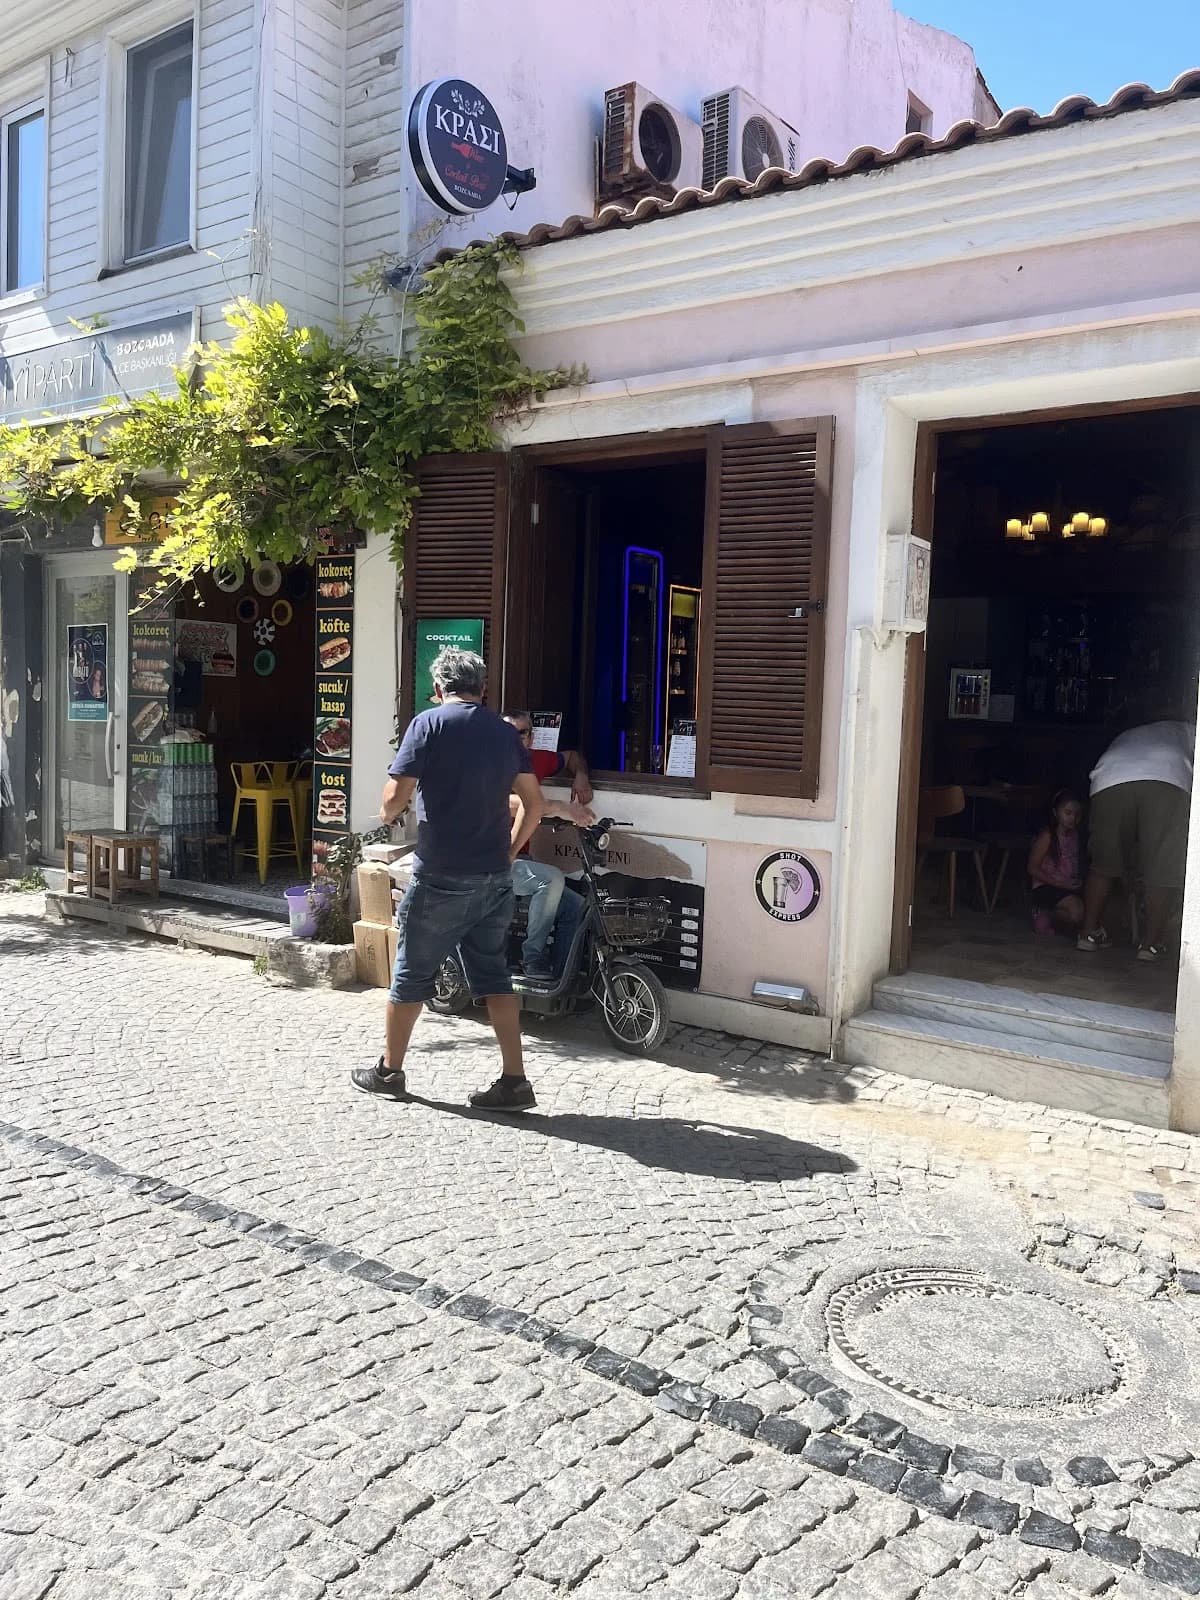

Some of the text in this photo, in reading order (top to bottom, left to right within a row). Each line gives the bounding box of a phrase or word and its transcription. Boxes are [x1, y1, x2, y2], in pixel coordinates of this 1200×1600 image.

[434, 104, 500, 155] ΚΡΑΣΙ
[116, 331, 175, 355] BOZCAADA
[113, 361, 129, 377] LÇE
[318, 563, 352, 581] kokoreç
[133, 624, 170, 638] kokoreç
[319, 618, 350, 633] köfte
[426, 634, 473, 642] COCKTAIL
[321, 698, 346, 716] kasap
[321, 771, 346, 787] tost
[607, 850, 632, 865] ENU
[779, 852, 802, 862] SHOT
[769, 908, 801, 921] EXPRESS
